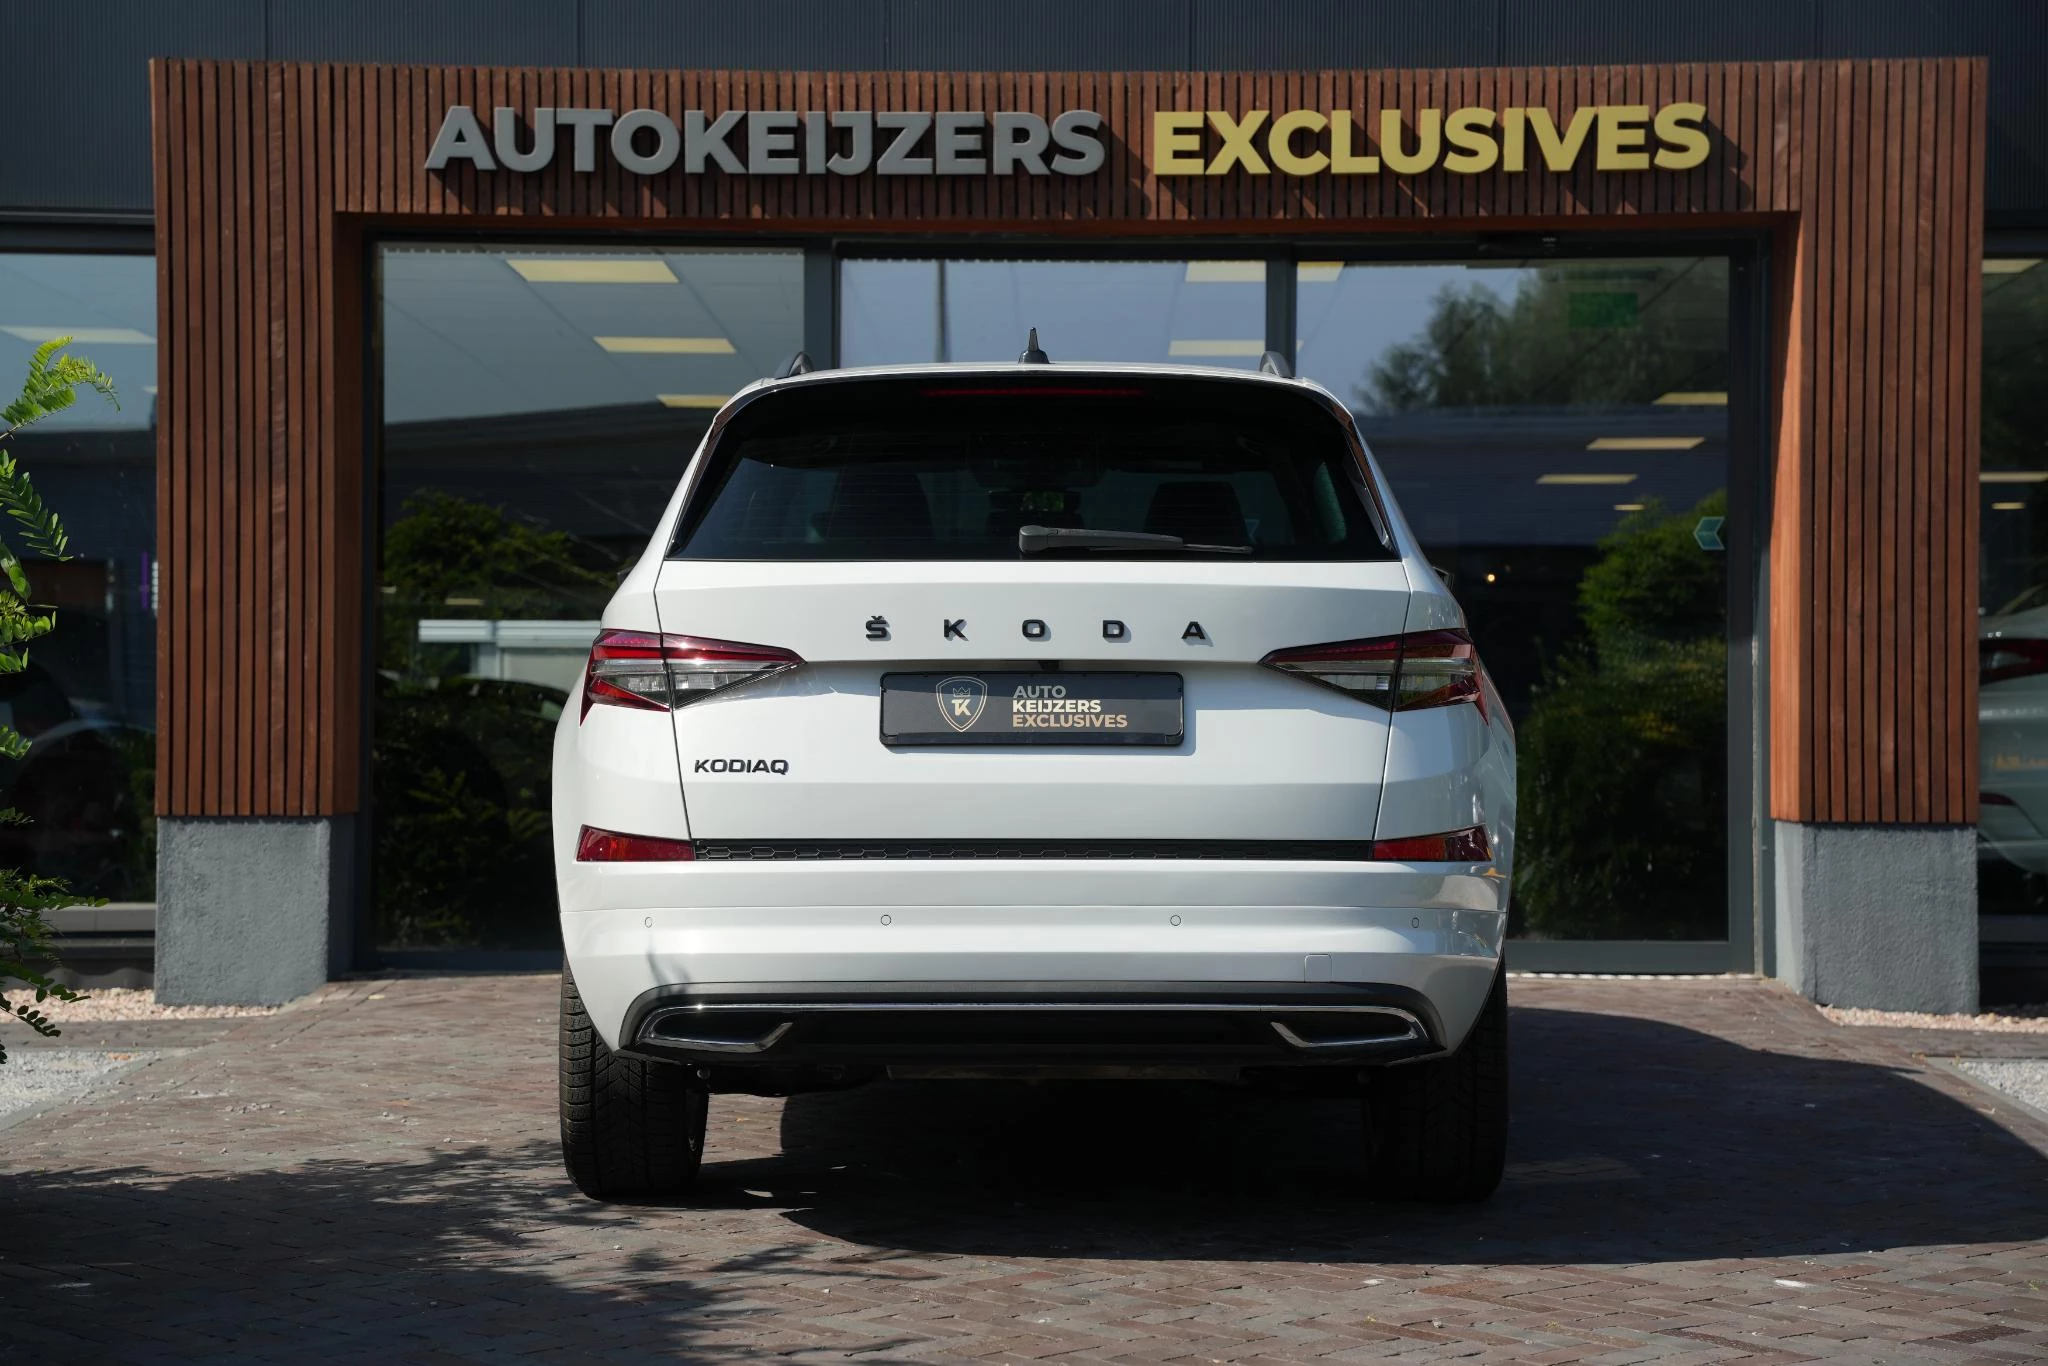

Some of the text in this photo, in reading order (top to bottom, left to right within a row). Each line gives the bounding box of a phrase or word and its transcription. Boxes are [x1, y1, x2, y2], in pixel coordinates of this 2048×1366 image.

[424, 102, 1711, 175] AUTOKEIJZERS EXCLUSIVES
[865, 615, 1206, 640] ŠKODA
[1012, 685, 1066, 699] AUTO
[1012, 699, 1101, 713] KEIJZERS
[1012, 713, 1128, 728] EXCLUSIVES
[694, 758, 790, 776] KODIAQ
